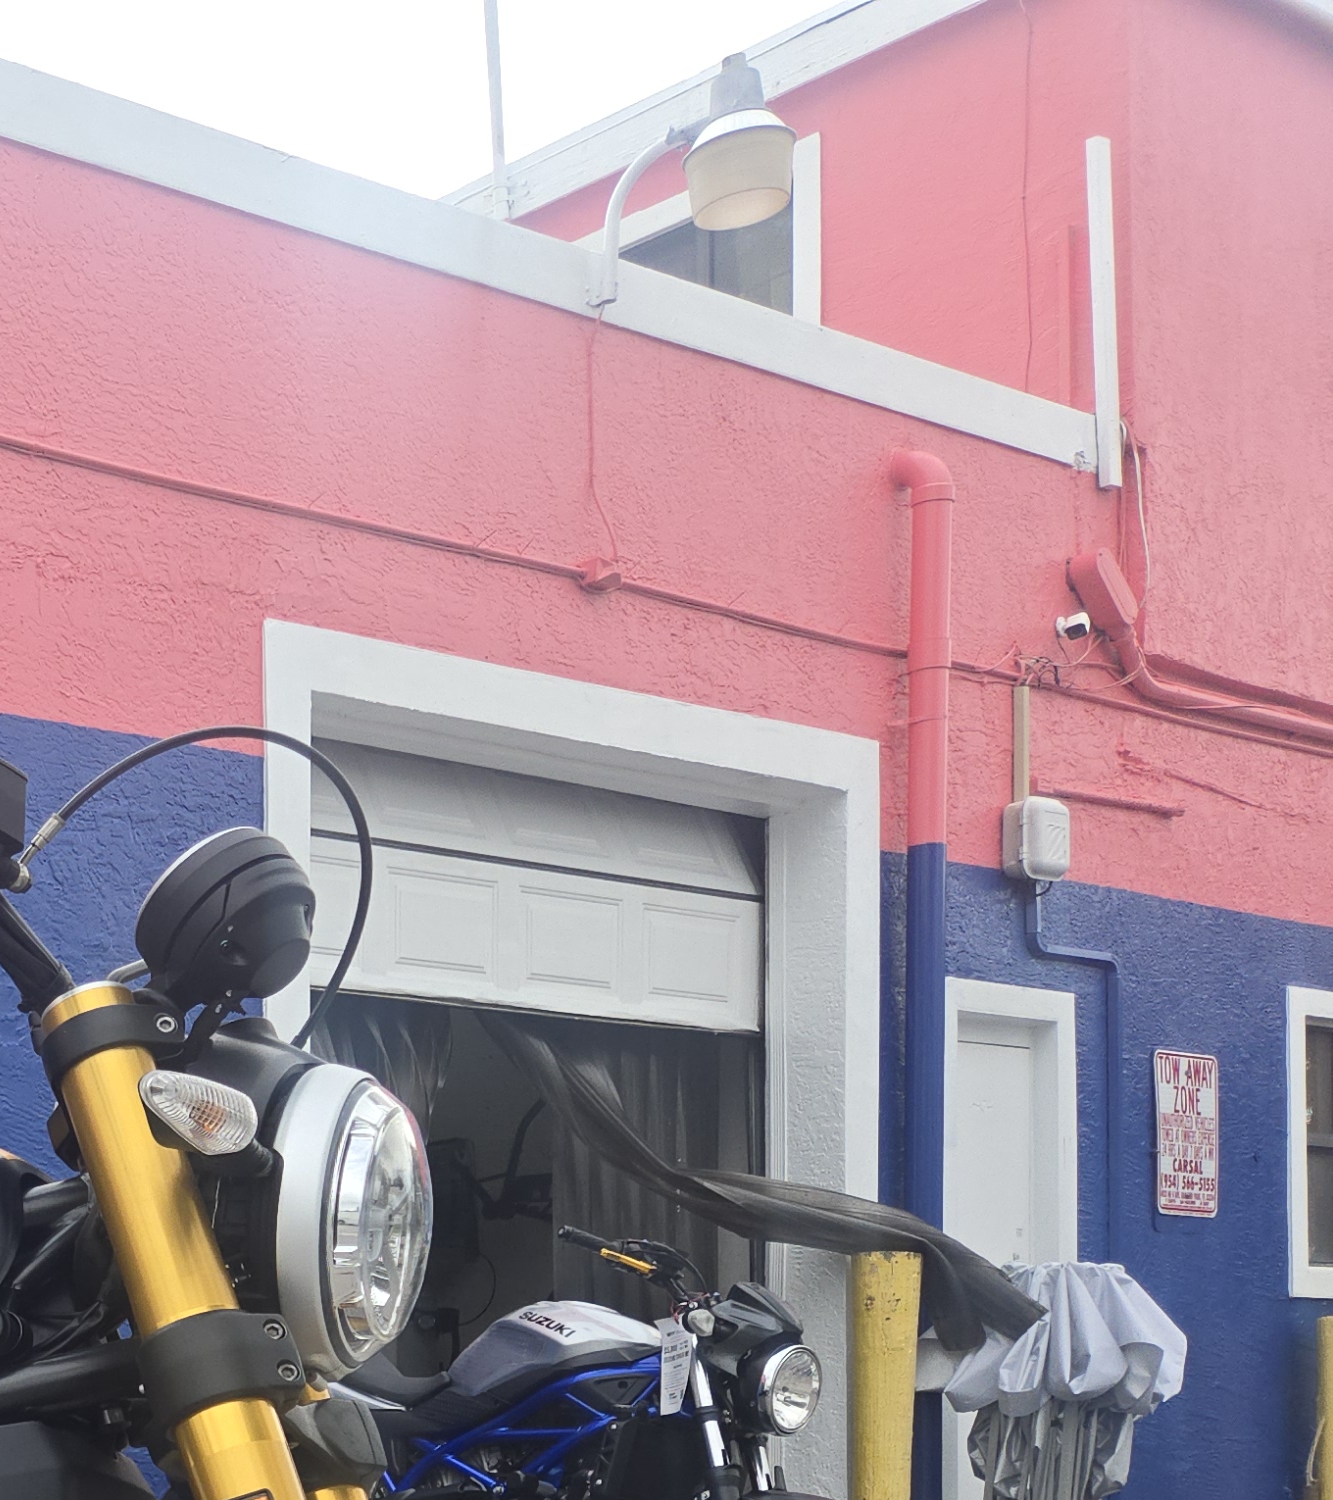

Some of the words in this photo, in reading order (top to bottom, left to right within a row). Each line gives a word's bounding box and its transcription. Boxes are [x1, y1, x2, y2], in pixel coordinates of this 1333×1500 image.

[1158, 1056, 1180, 1085] TOW
[1186, 1060, 1214, 1089] AWAY
[1173, 1086, 1202, 1116] ZONE
[1173, 1158, 1203, 1175] CARSAL
[1160, 1172, 1180, 1191] (954)
[518, 1311, 576, 1338] SUZUKI
